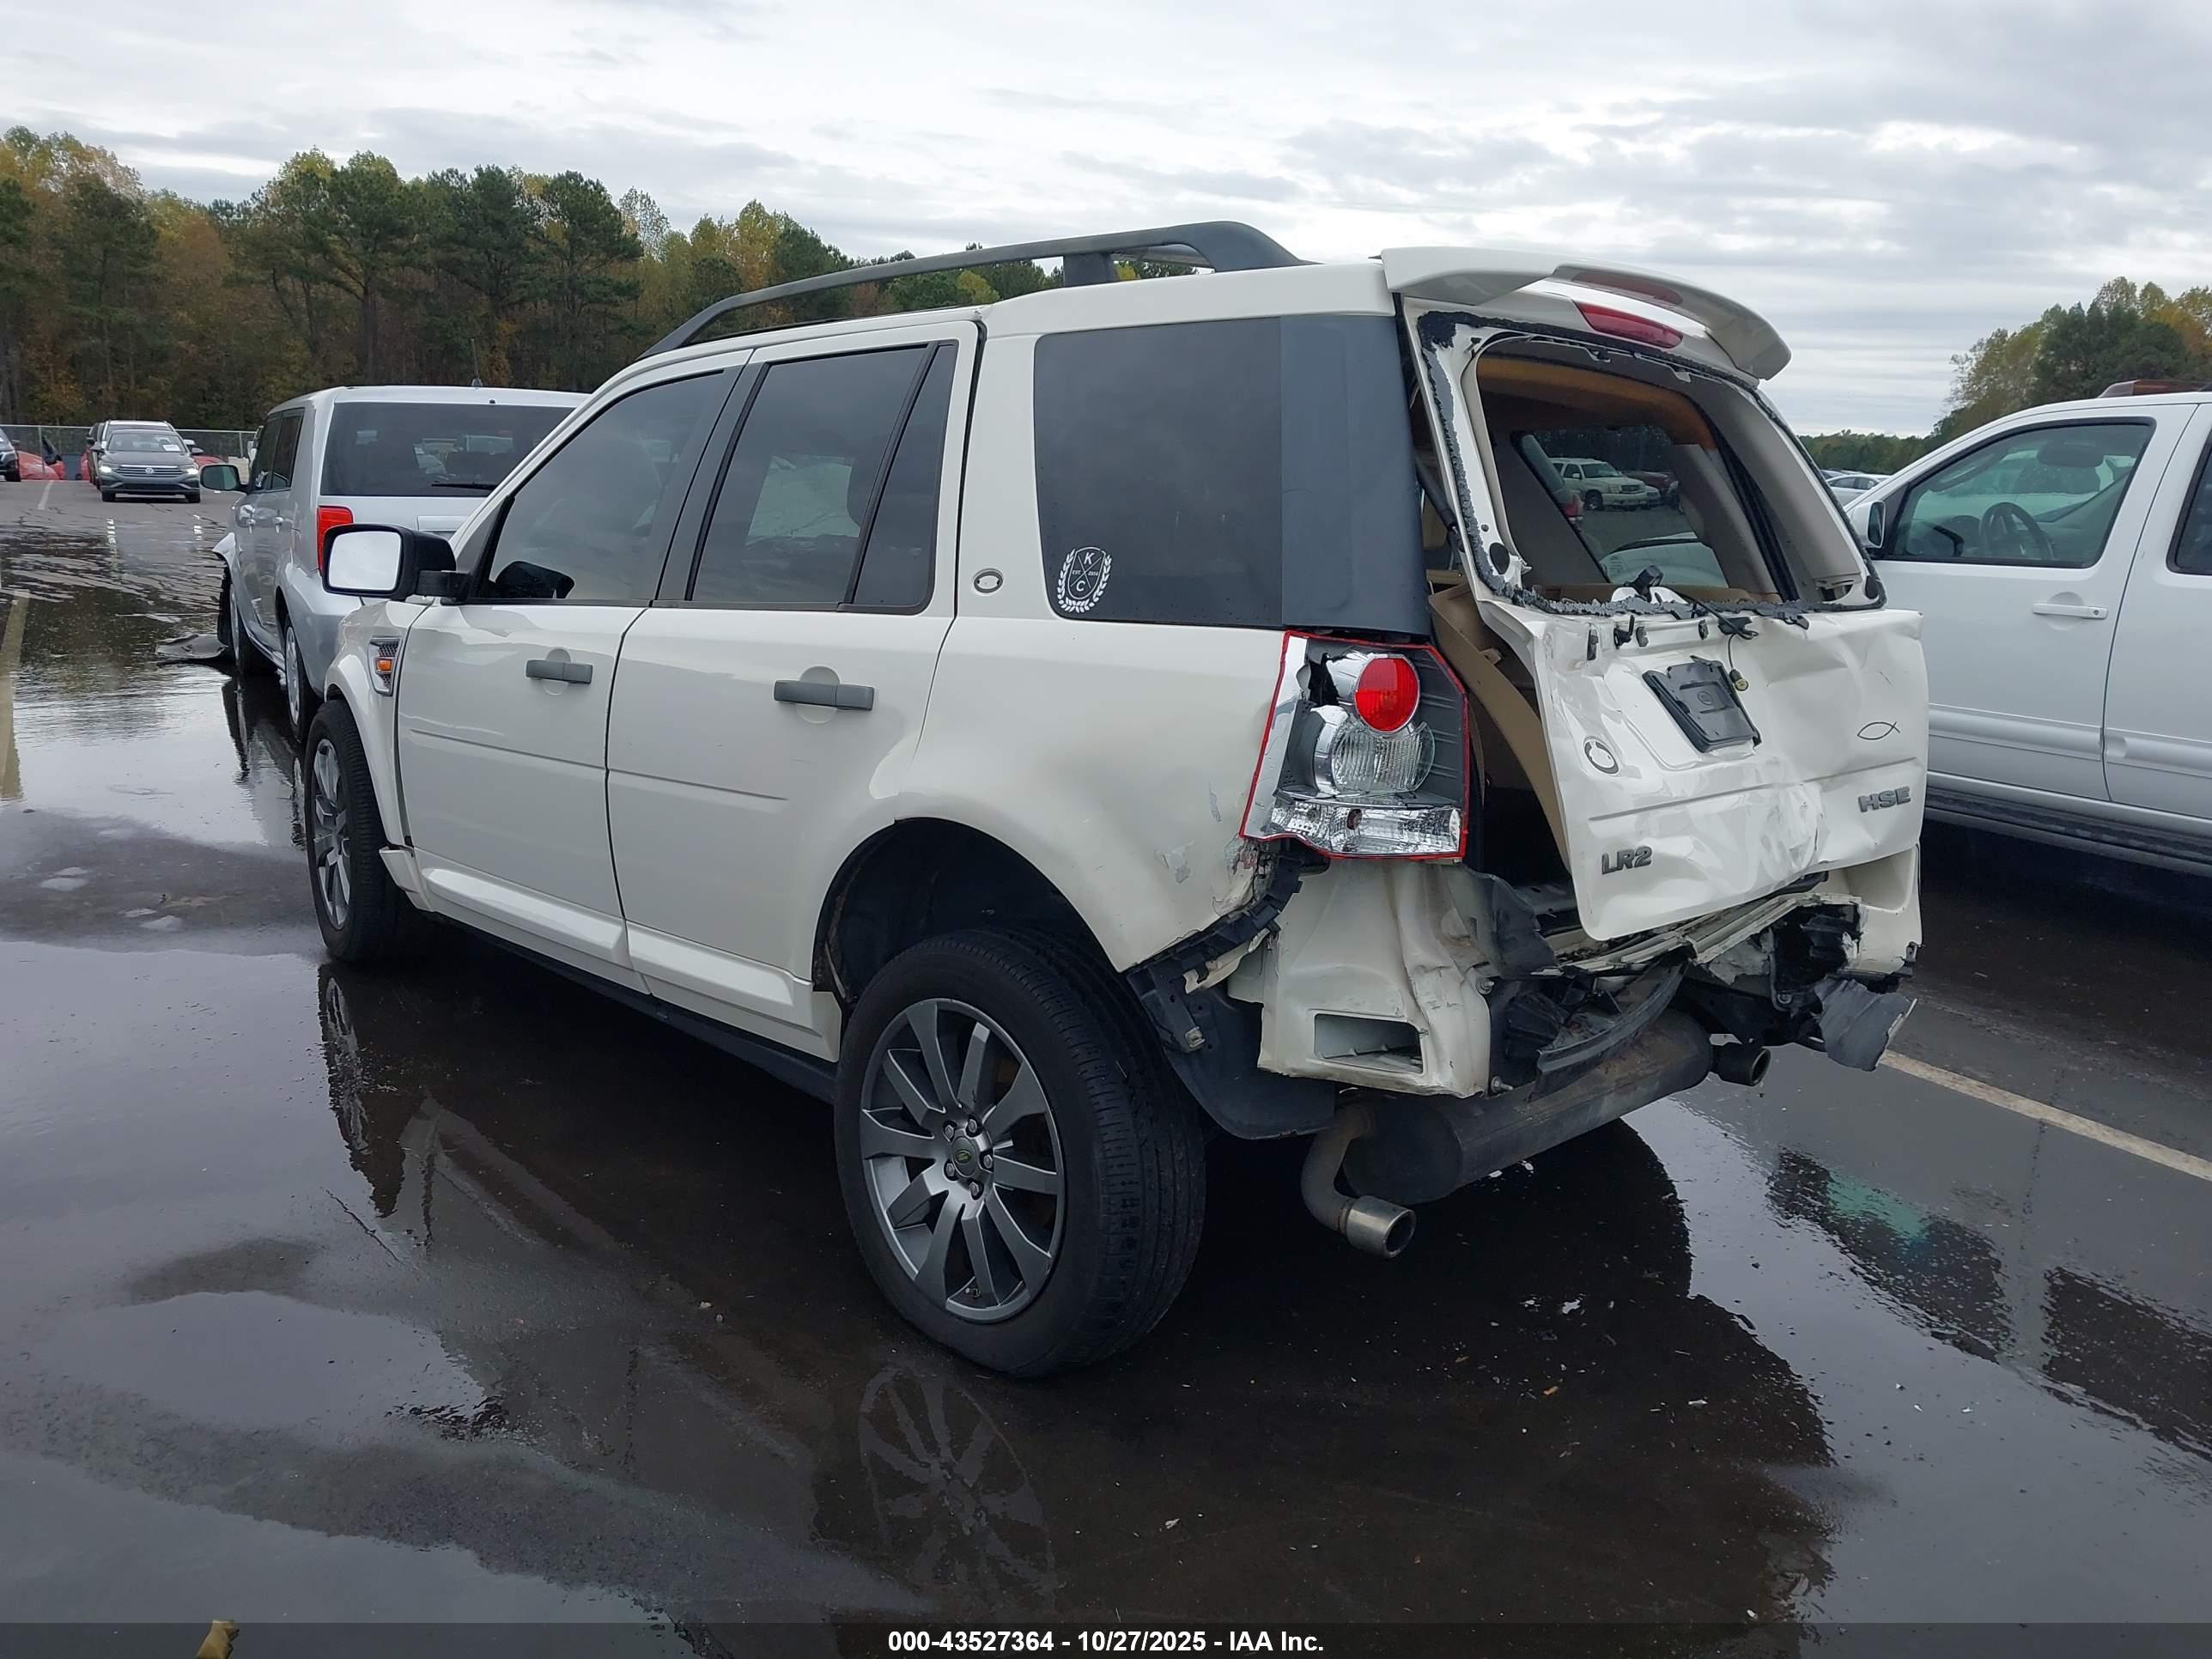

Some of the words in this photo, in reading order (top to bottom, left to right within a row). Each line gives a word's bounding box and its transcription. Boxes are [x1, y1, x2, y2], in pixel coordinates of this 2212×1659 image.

[1084, 552, 1095, 565] K
[1076, 580, 1085, 592] C
[1857, 786, 1911, 813] HSE
[1601, 846, 1652, 875] LR2
